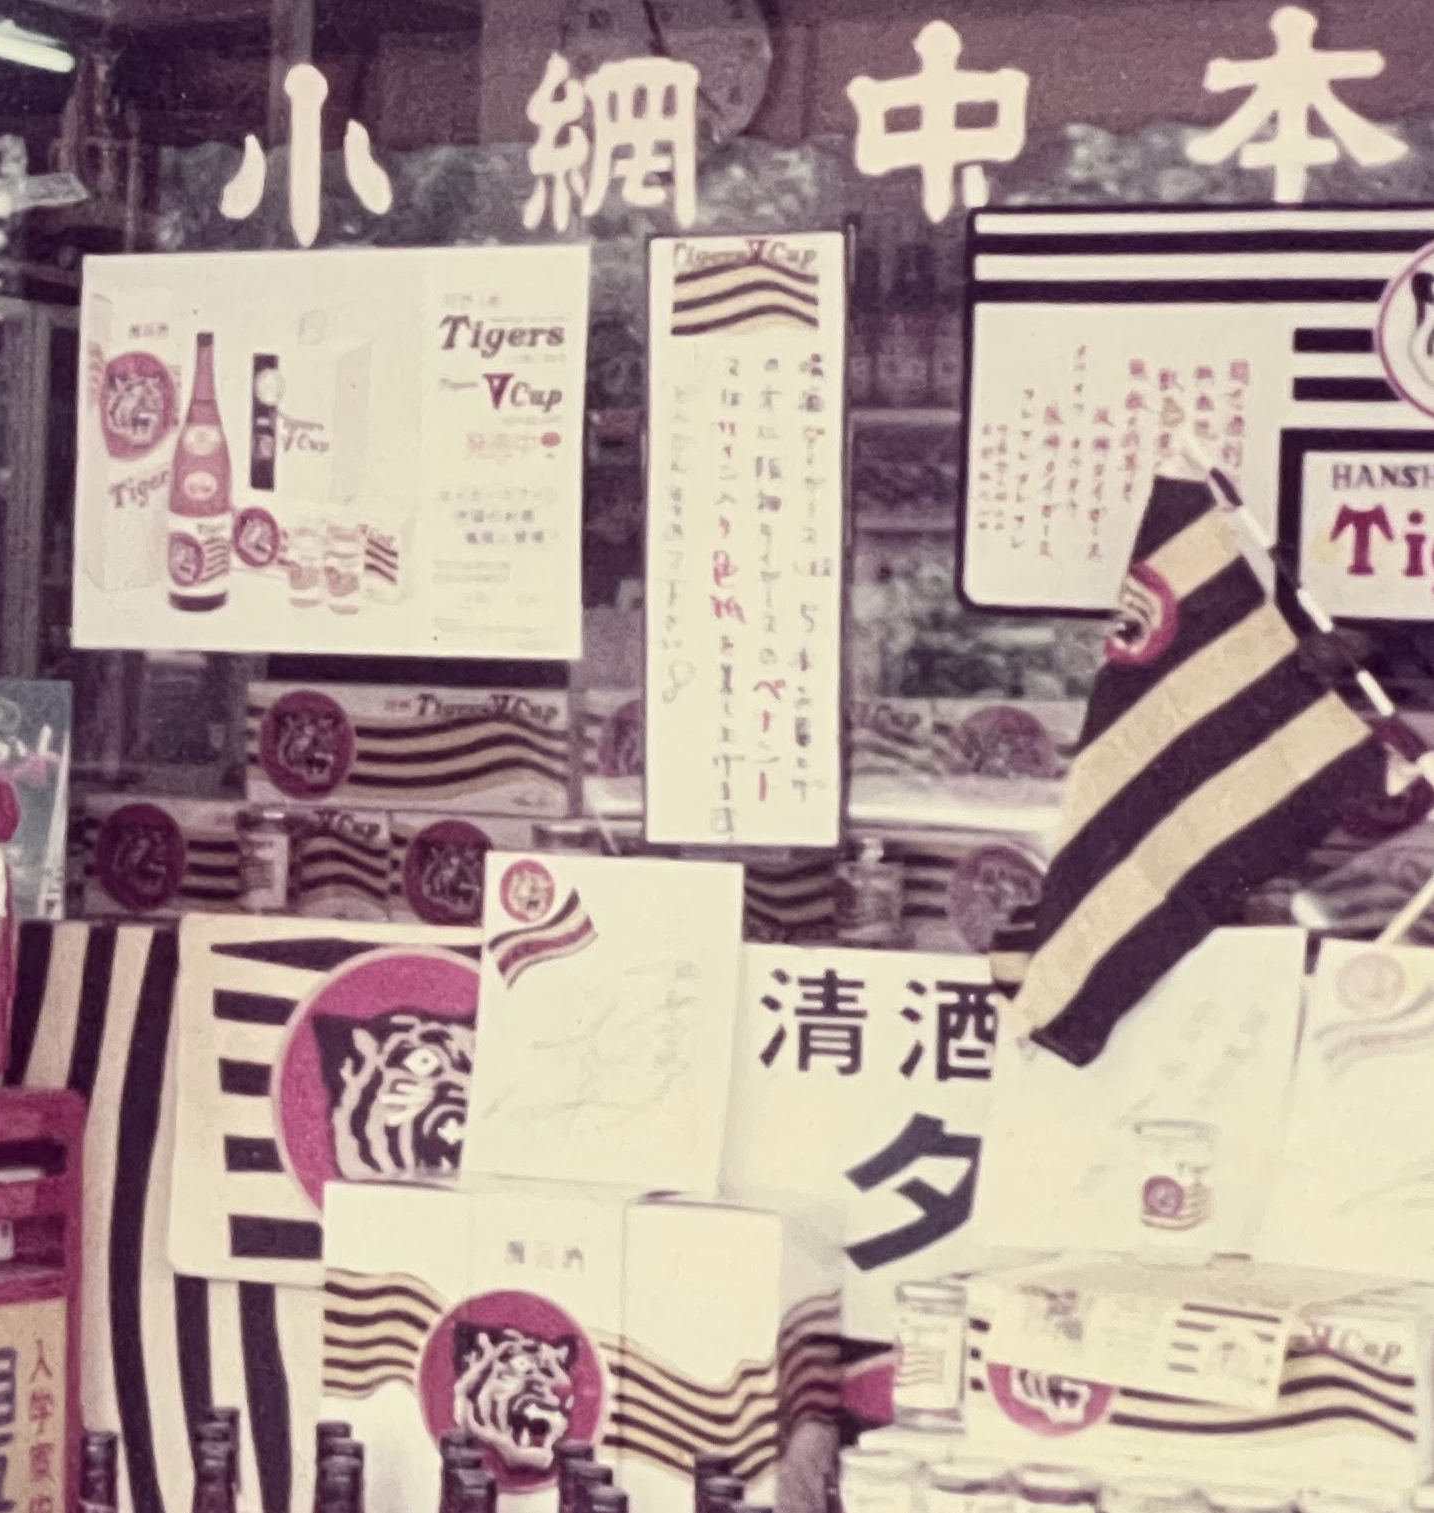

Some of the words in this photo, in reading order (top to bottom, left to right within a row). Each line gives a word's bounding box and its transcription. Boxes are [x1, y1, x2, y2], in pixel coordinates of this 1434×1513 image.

[438, 314, 565, 360] Tigers
[510, 381, 564, 413] Cup
[1329, 502, 1434, 579] Ti
[759, 967, 1000, 1081] 清酒
[841, 1111, 983, 1272] タ
